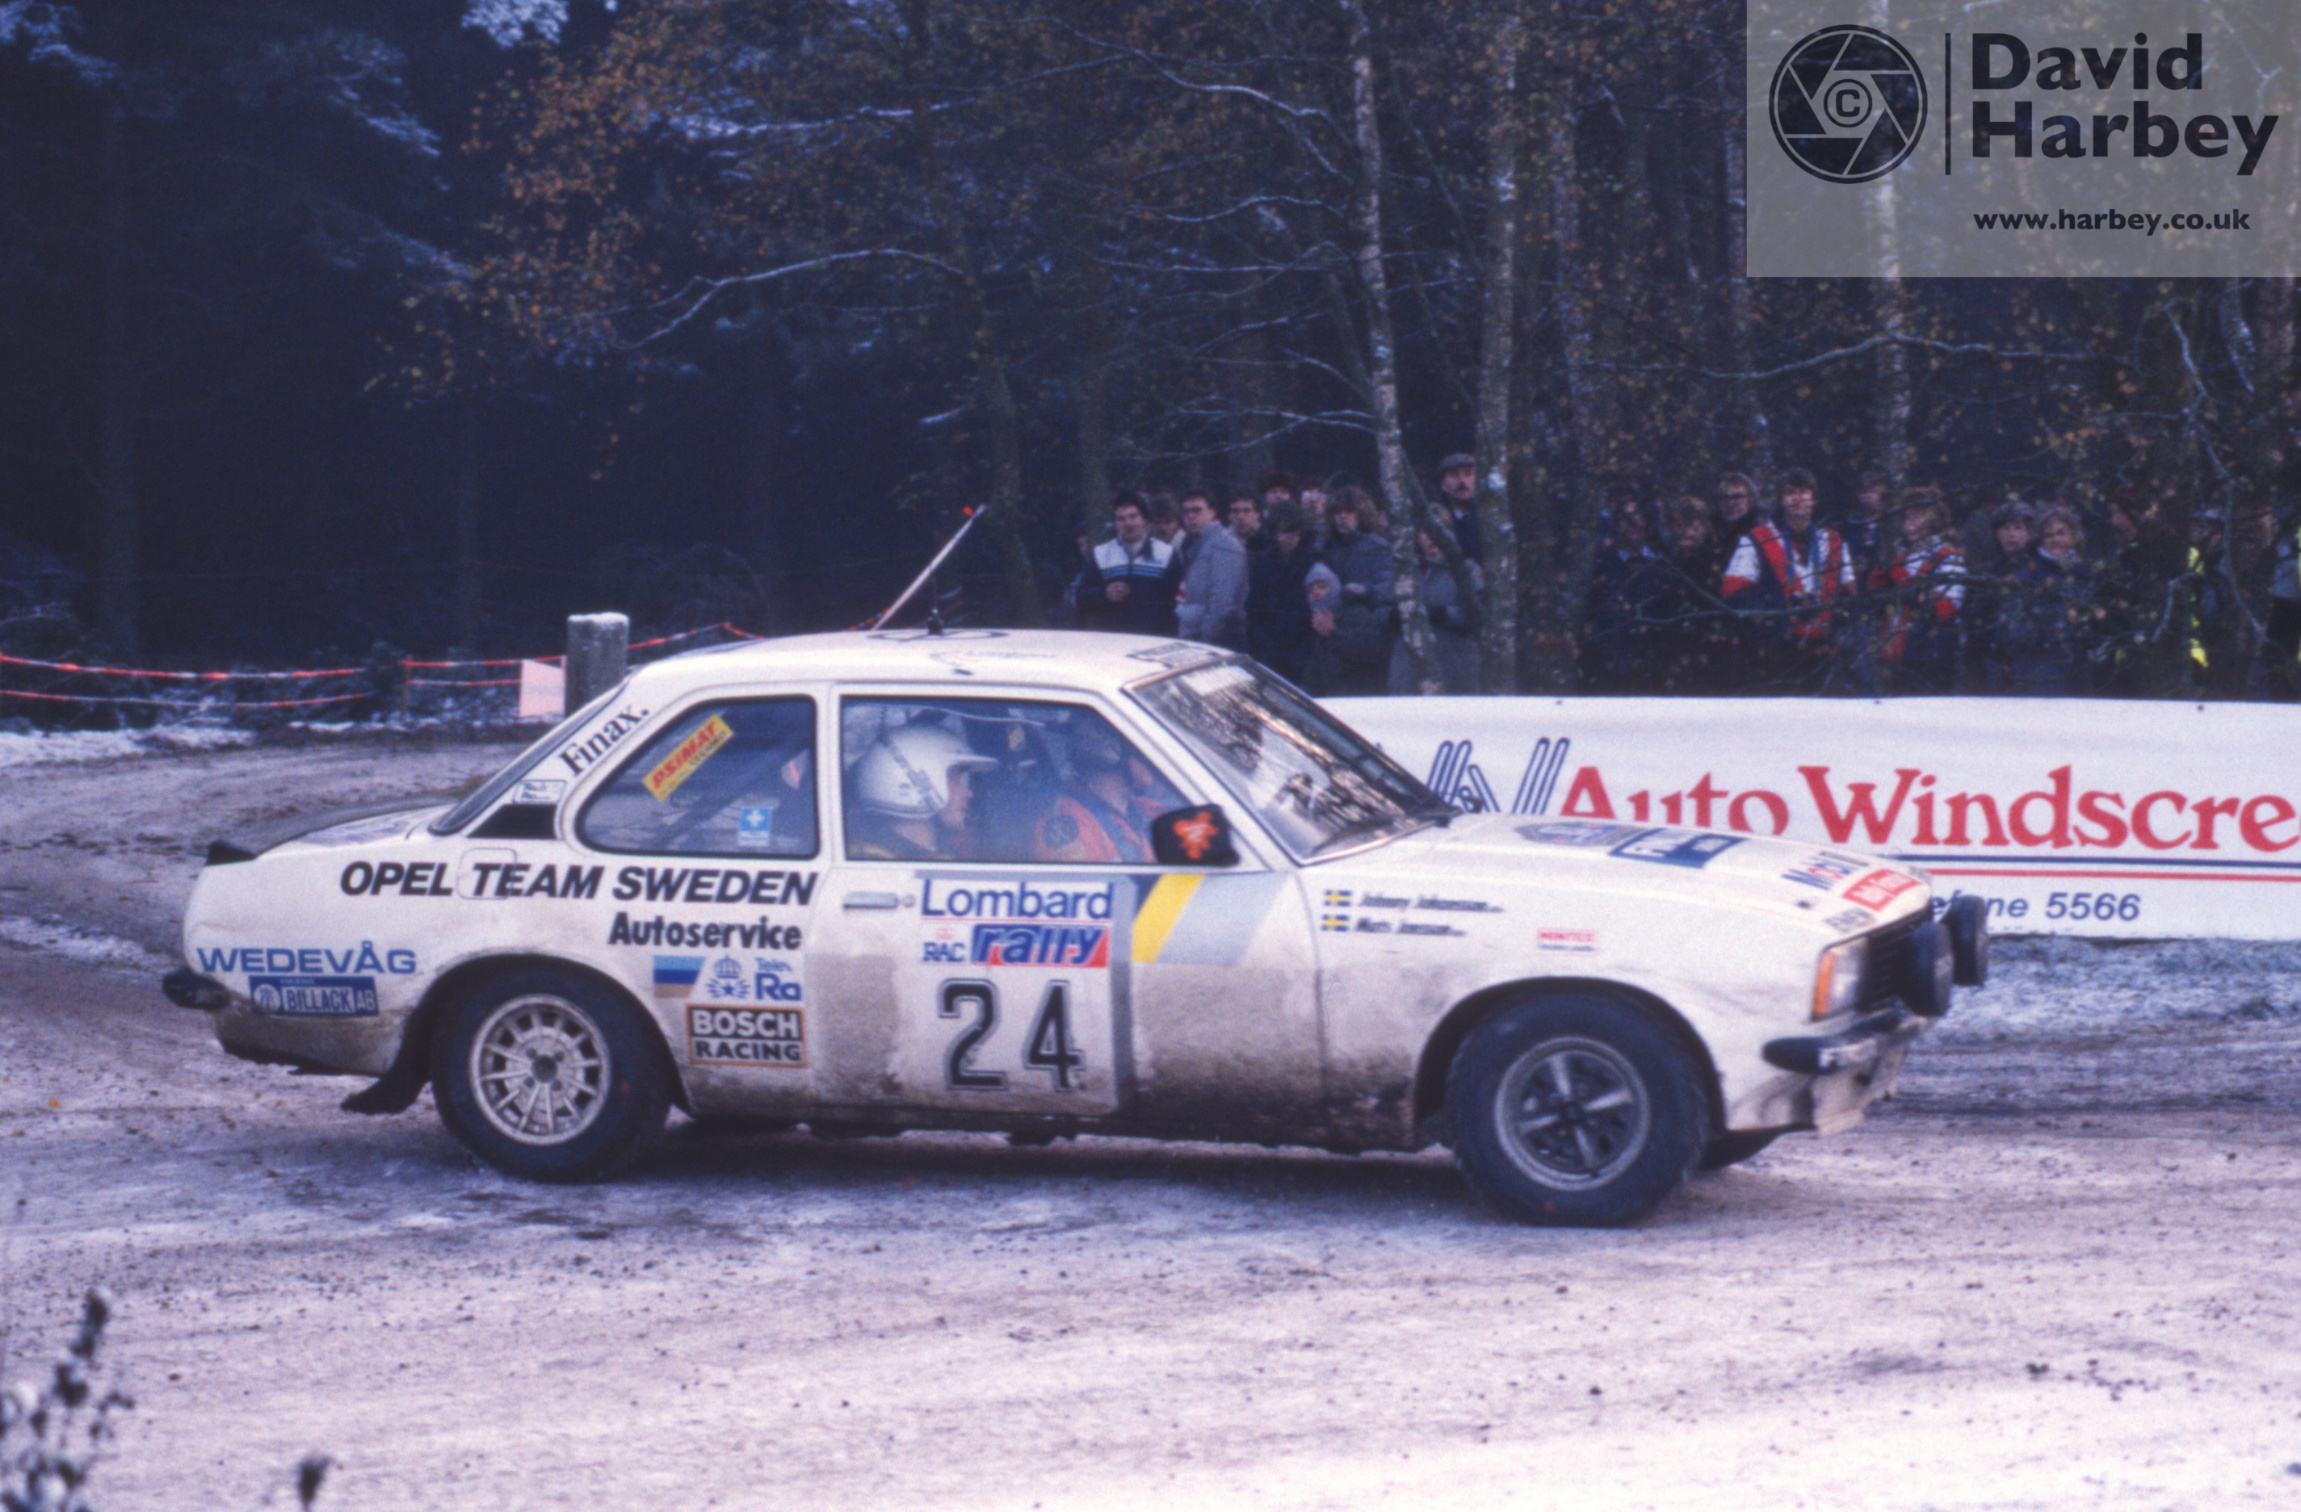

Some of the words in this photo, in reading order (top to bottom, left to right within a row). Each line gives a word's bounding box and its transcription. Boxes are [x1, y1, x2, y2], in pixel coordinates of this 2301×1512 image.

[1559, 766, 1790, 836] Auto
[1797, 764, 2301, 852] Windscre
[340, 861, 454, 896] OPEL
[471, 862, 604, 899] TEAM
[612, 866, 819, 906] SWEDEN
[921, 879, 1114, 919] Lombard
[2045, 891, 2142, 921] 5566
[608, 912, 802, 949] Autoservice
[978, 927, 1106, 964] rally
[196, 940, 417, 974] WEDEVÅG
[922, 942, 966, 963] RAC
[285, 987, 352, 1013] BILLACK
[356, 989, 376, 1011] AB
[756, 972, 802, 1001] Ra
[691, 1009, 800, 1039] BOSCH
[937, 977, 1087, 1092] 24
[695, 1040, 801, 1061] RACING
